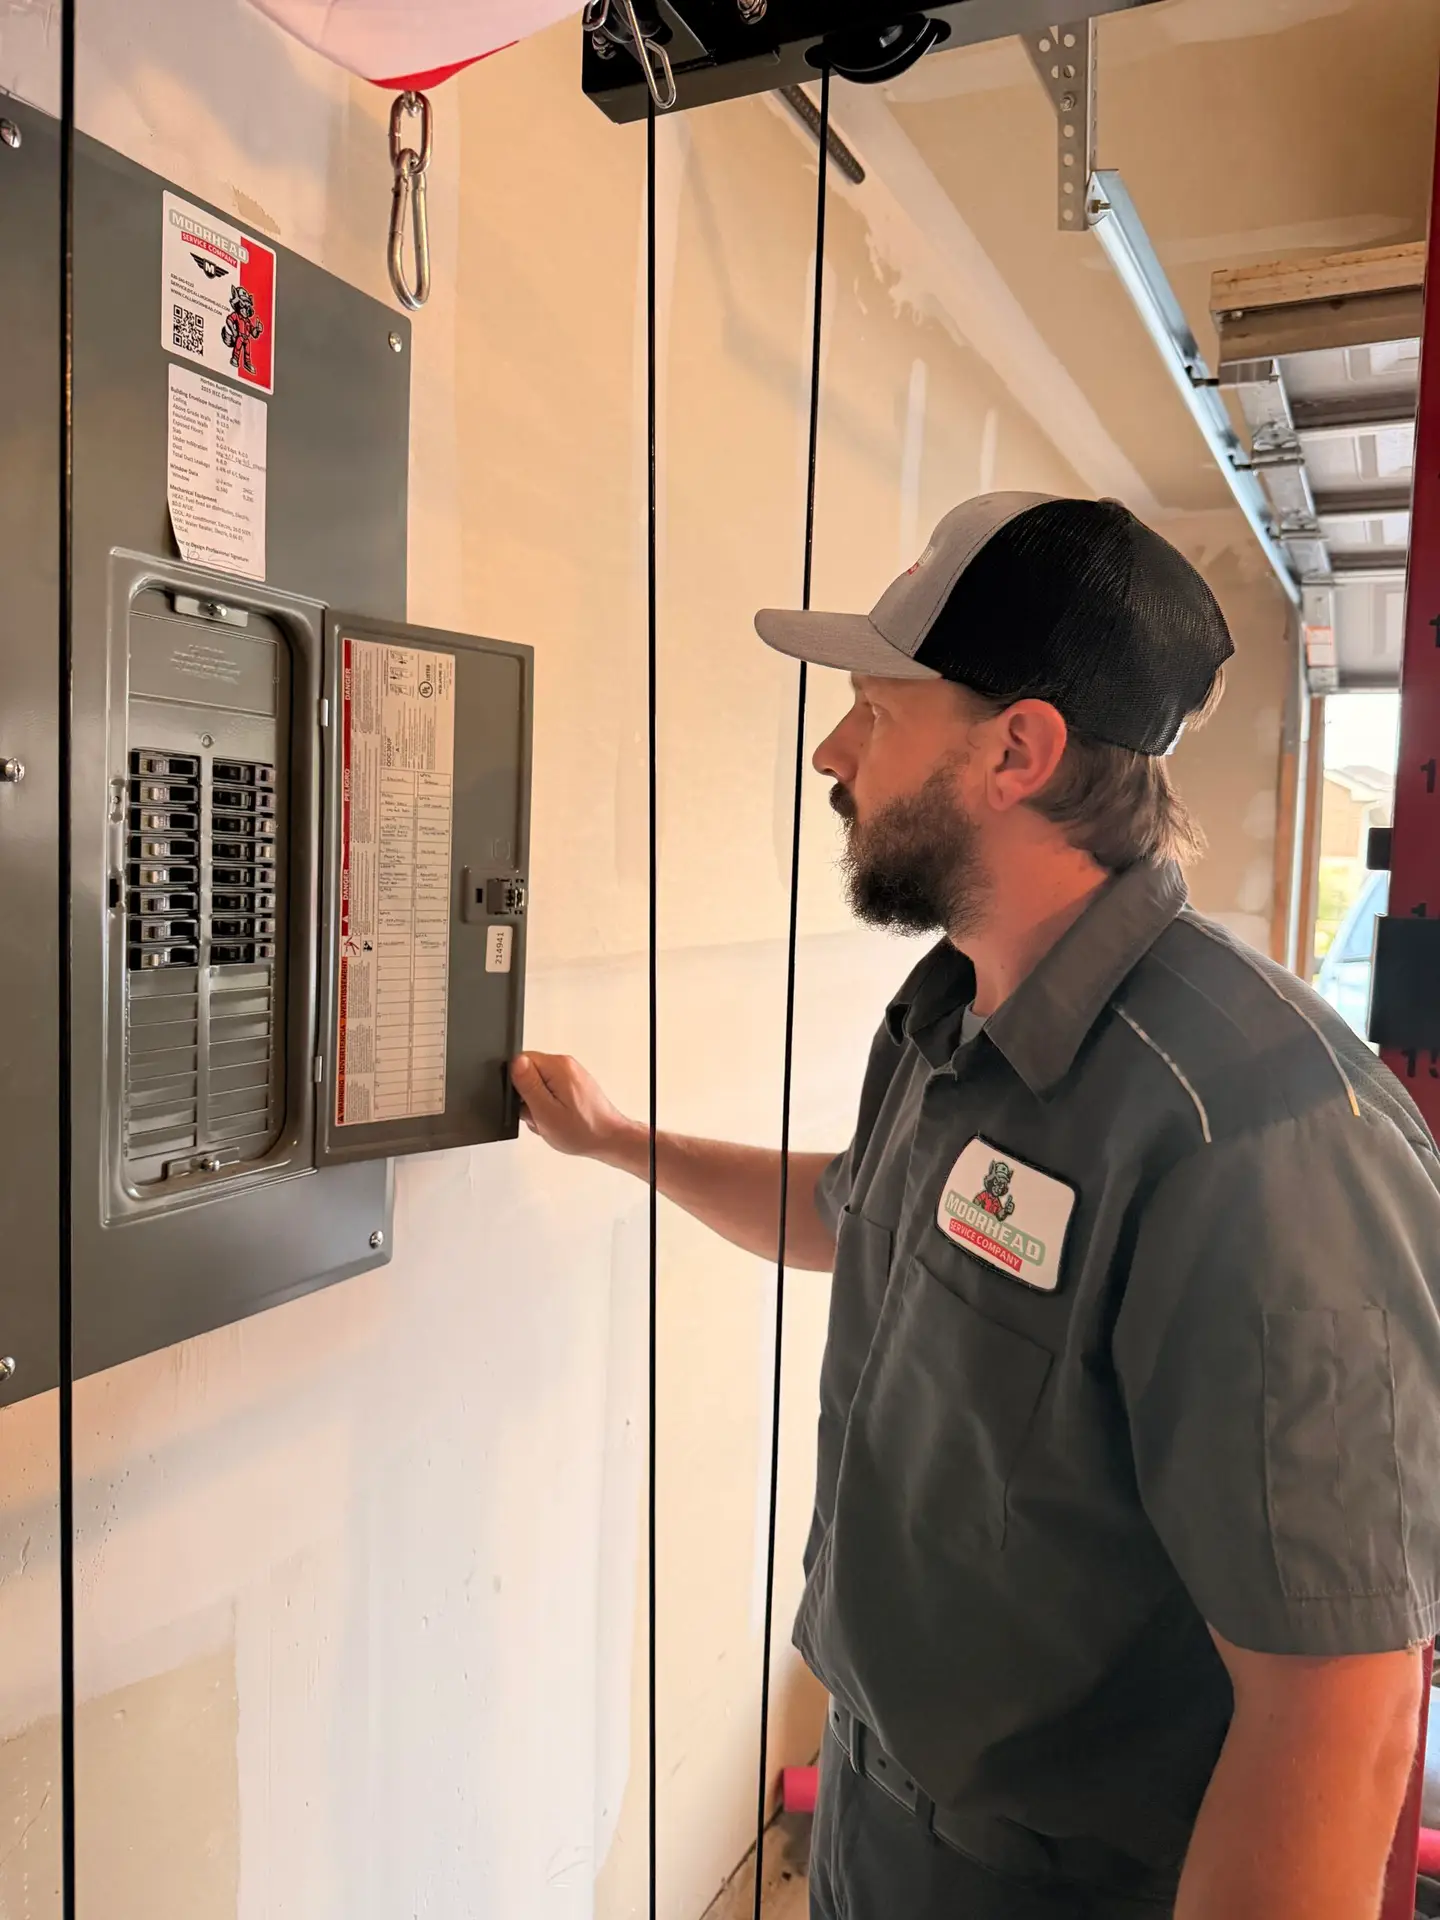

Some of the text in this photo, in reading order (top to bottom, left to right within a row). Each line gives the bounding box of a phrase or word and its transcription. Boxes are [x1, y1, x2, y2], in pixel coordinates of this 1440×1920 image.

[172, 212, 246, 262] MOORHEAD
[182, 233, 237, 266] SERVICE COMPANY
[205, 262, 215, 275] M
[170, 386, 188, 399] Building
[189, 393, 207, 405] Envelope
[172, 404, 186, 412] Above
[172, 411, 196, 424] Foundation
[172, 419, 190, 430] Exposed
[170, 484, 217, 503] Mechanical Equipment
[191, 543, 205, 551] Design
[206, 546, 230, 557] Professional
[494, 932, 504, 964] 214941
[946, 1192, 1041, 1261] MOORHEAD
[950, 1220, 1020, 1267] SERVICE COMPANY
